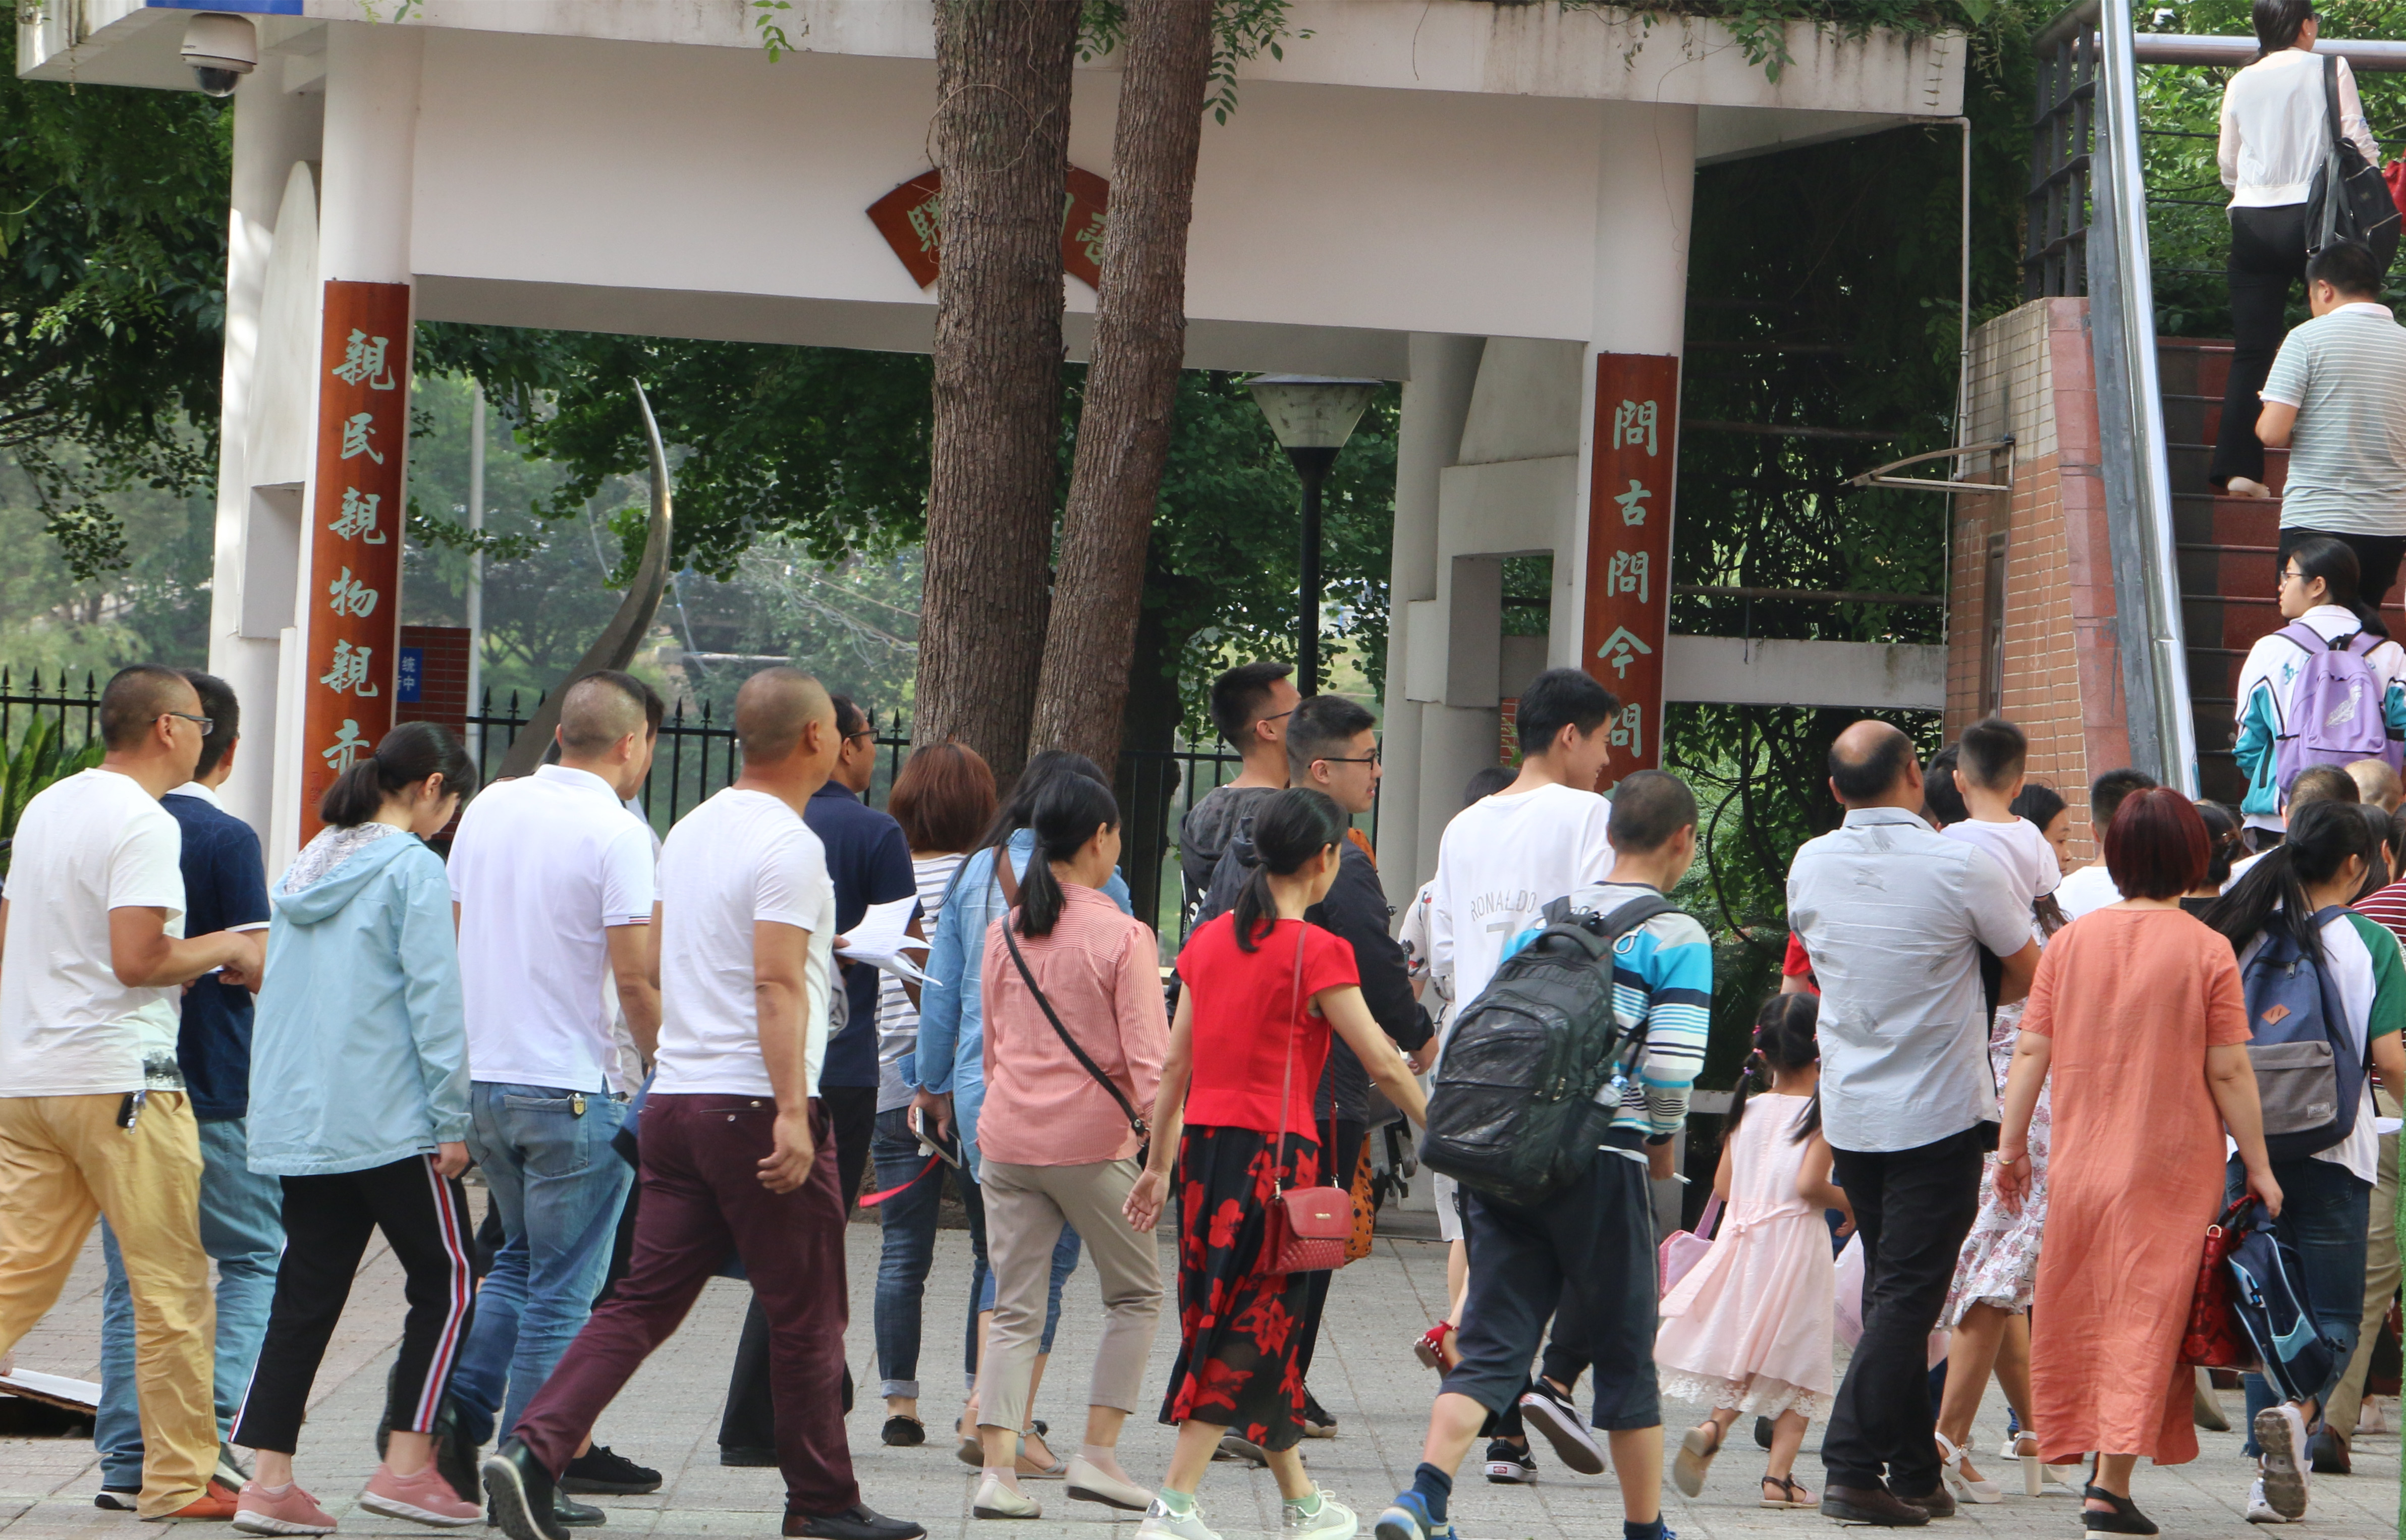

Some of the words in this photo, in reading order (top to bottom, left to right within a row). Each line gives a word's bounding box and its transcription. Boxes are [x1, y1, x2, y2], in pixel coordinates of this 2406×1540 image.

[1597, 400, 1658, 800] 問古問今問
[1470, 890, 1537, 921] RONALDO
[1486, 921, 1515, 966] 7
